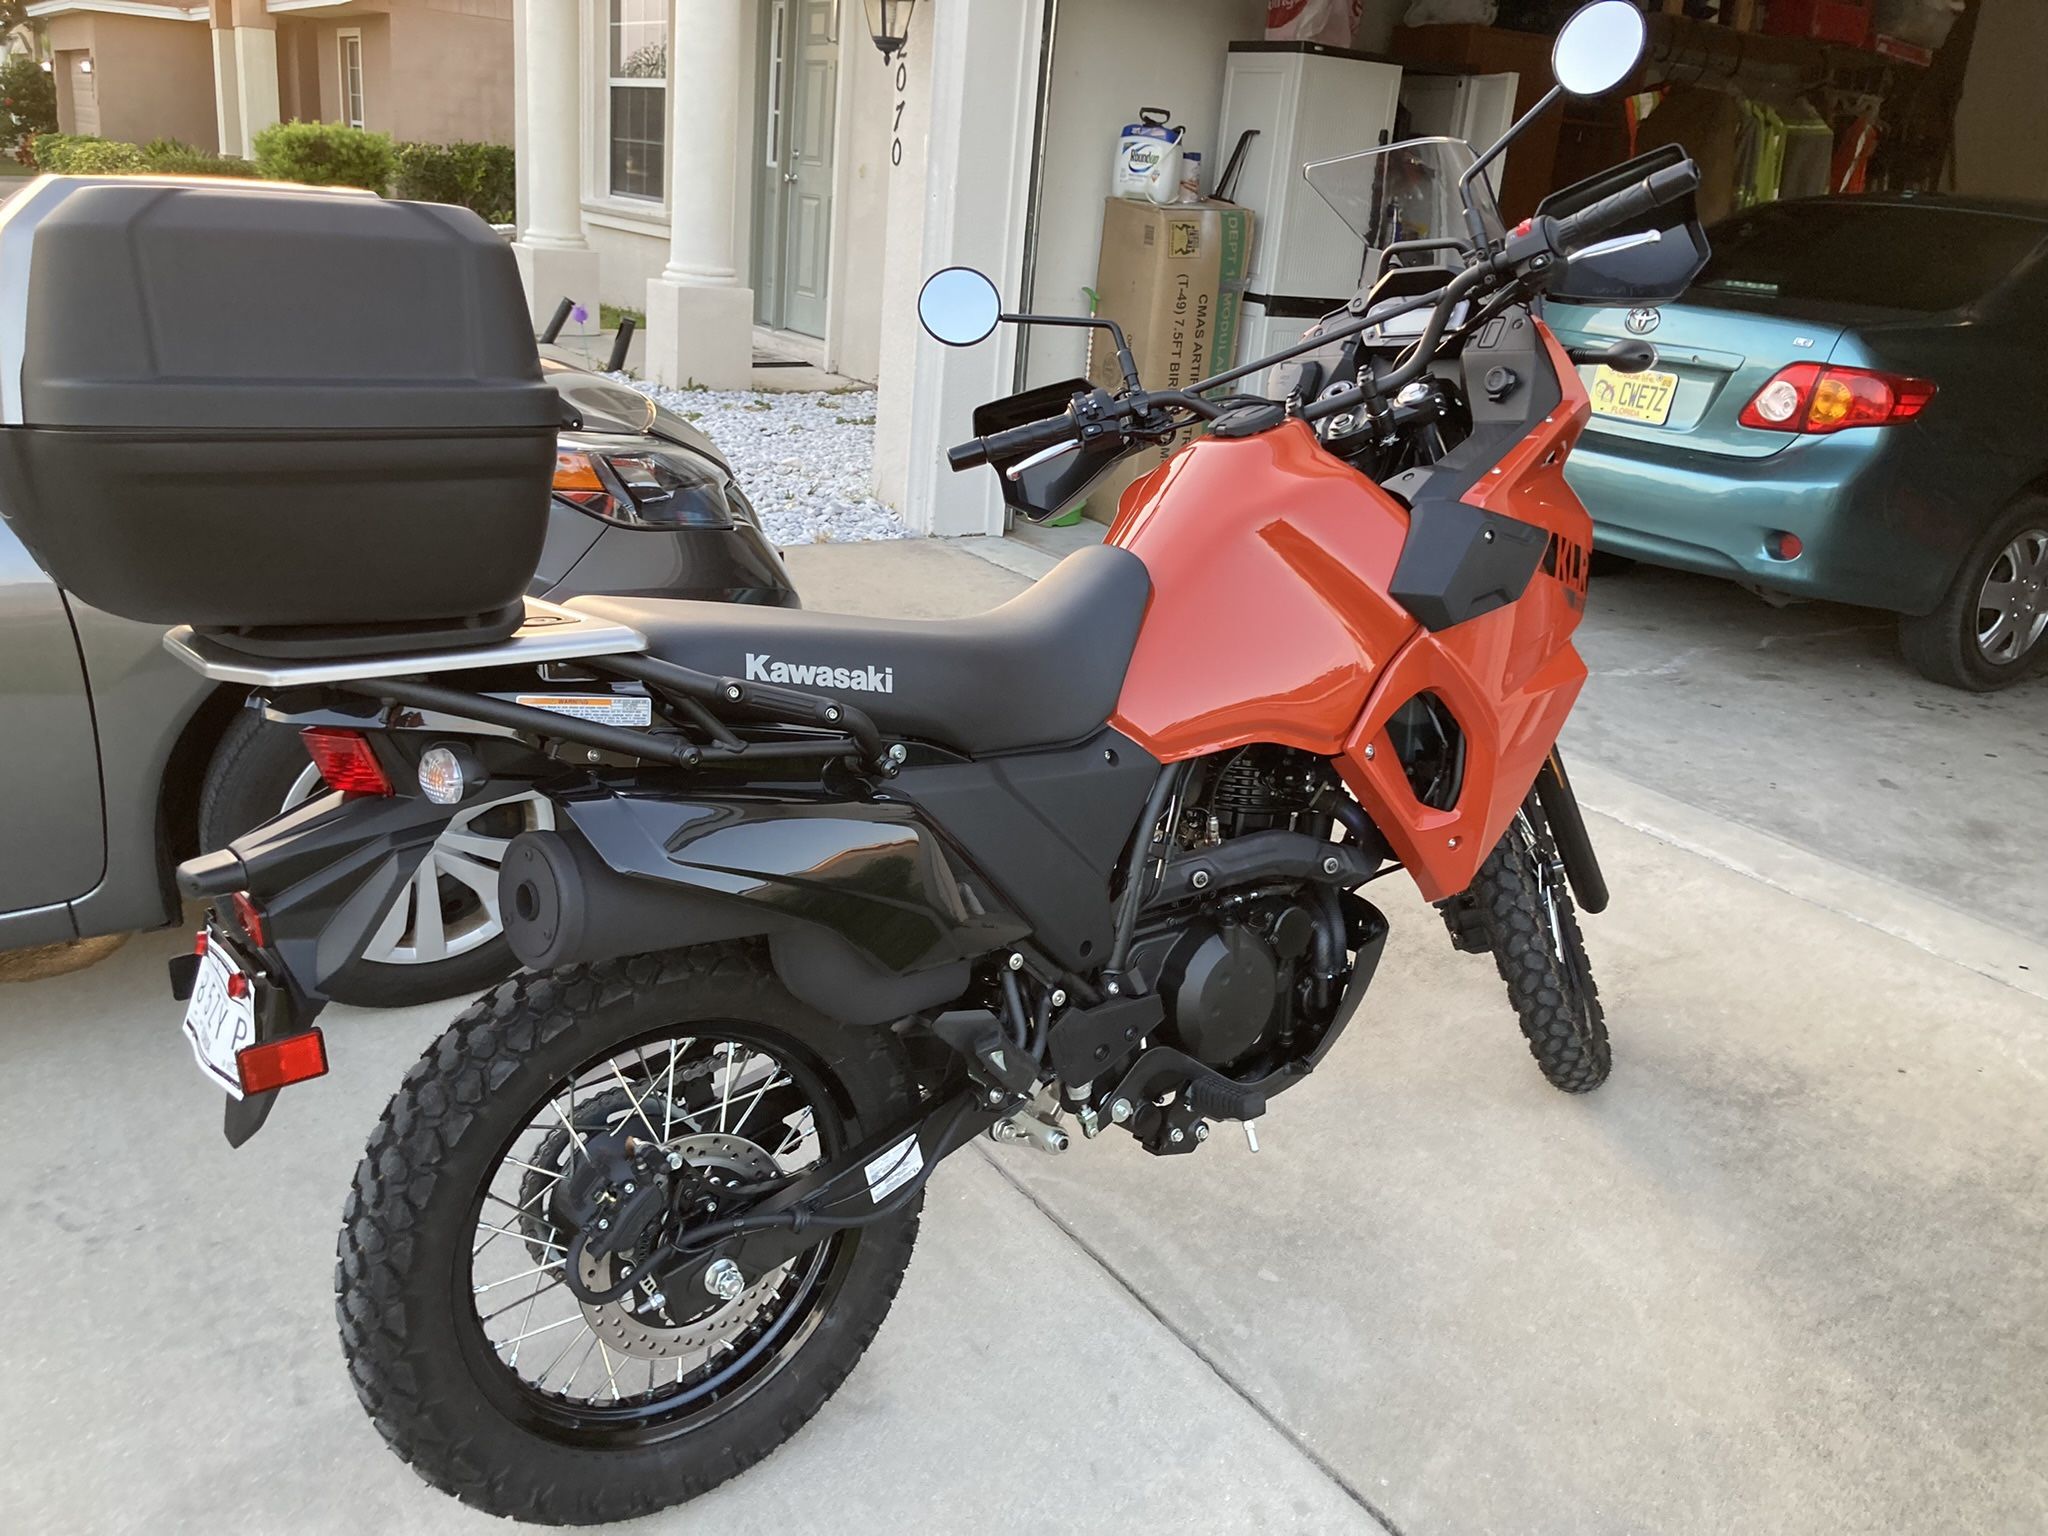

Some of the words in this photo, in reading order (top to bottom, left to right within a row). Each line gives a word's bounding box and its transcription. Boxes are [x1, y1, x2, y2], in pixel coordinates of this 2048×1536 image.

[1227, 217, 1239, 264] DEPT
[1172, 273, 1189, 316] (T-49)
[1194, 294, 1208, 339] CMAS
[1171, 319, 1185, 358] 7.5FT
[1167, 362, 1181, 392] BIR
[1188, 341, 1203, 385] ARTIF
[1618, 381, 1669, 412] CWE7Z
[745, 652, 893, 694] Kawasaki
